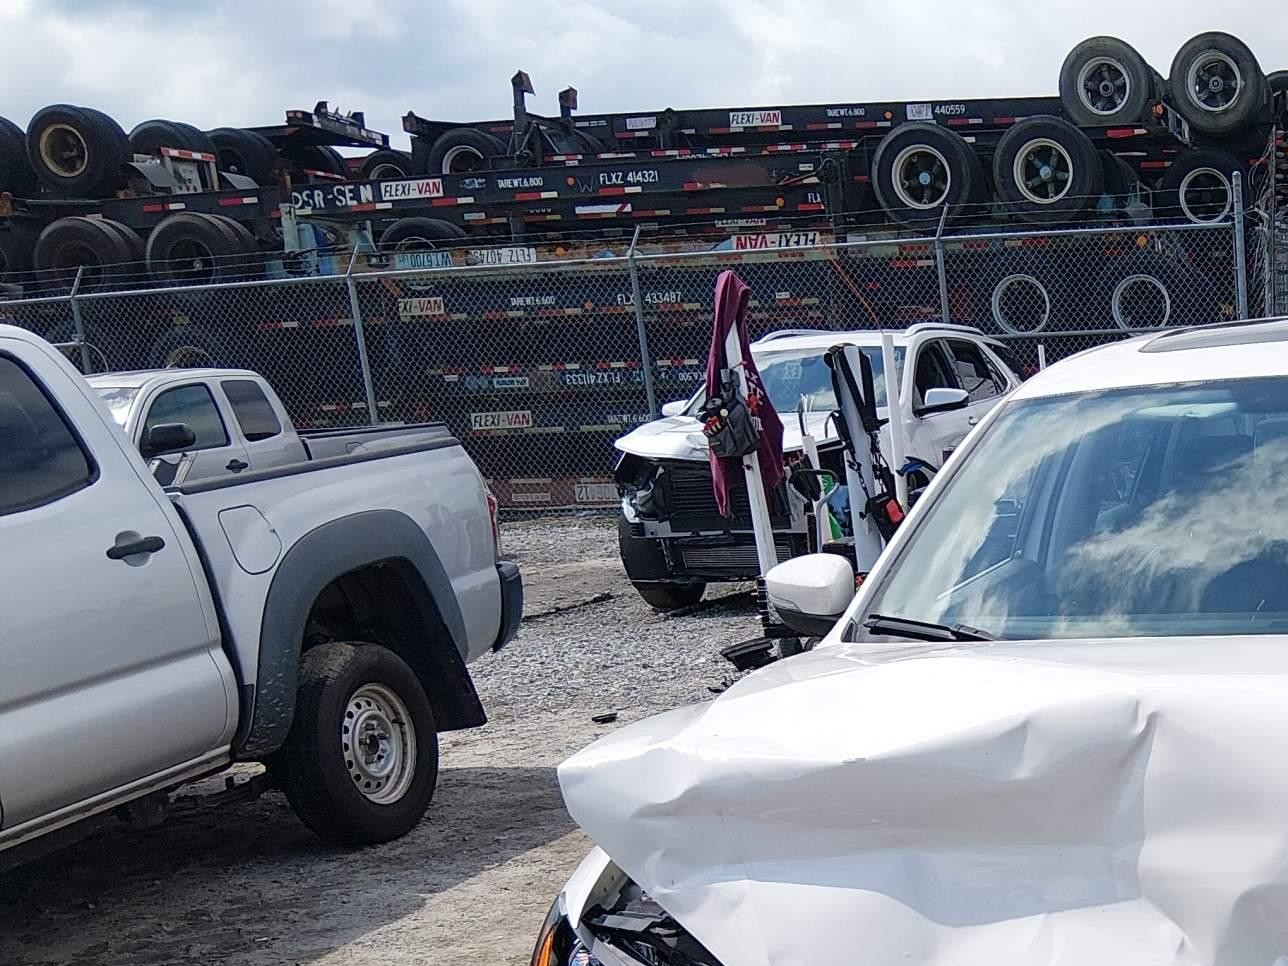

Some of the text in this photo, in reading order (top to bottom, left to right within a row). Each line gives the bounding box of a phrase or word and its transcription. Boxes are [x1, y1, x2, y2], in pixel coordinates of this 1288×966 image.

[934, 104, 966, 115] 440559
[731, 111, 781, 126] FLEXI-VAN
[599, 170, 659, 185] FLXZ 414321
[383, 181, 441, 197] FLEXI-VAN
[736, 232, 817, 250] FLEXI-VAN
[617, 293, 636, 305] FLX
[473, 413, 530, 428] FLEXI-VAN
